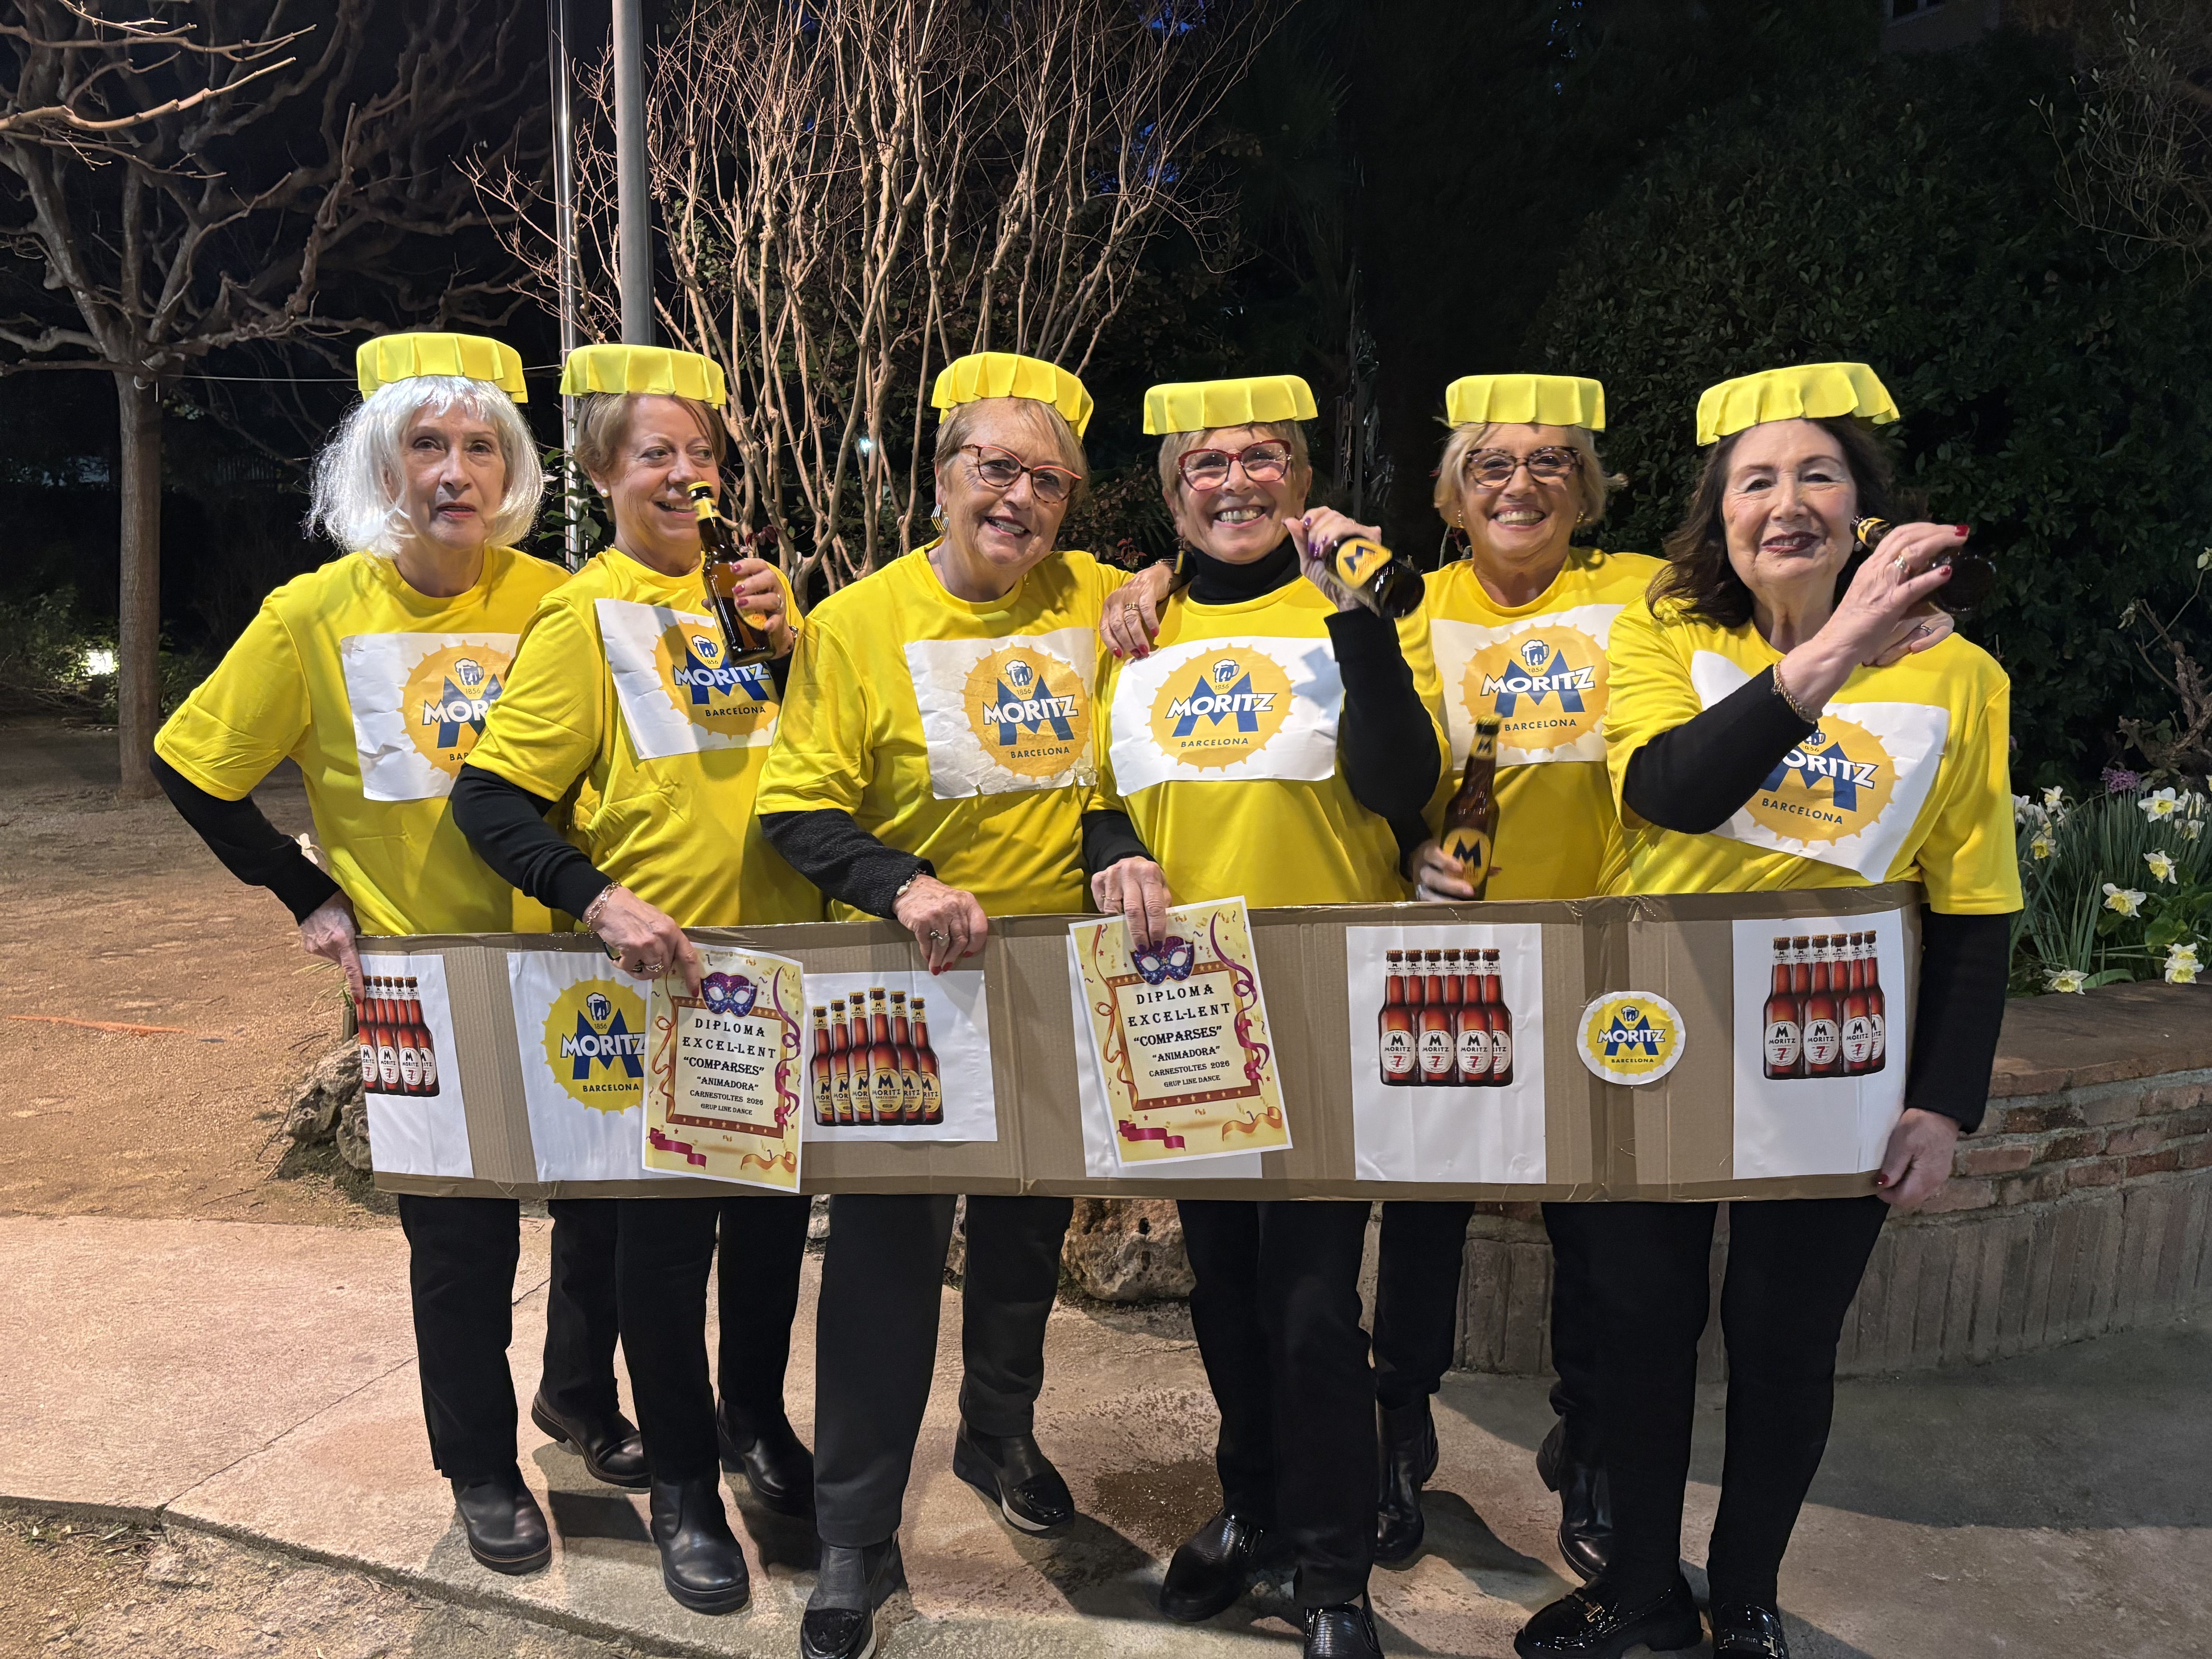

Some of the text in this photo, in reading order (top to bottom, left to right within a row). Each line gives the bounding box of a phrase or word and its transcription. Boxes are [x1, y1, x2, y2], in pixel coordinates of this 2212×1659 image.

[673, 663, 771, 686] MORITZ
[1480, 666, 1595, 696] MORITZ
[705, 706, 766, 716] BARCELONA
[982, 694, 1079, 725] MORITZ
[1165, 693, 1278, 719] MORITZ
[1505, 719, 1577, 731] BARCELONA
[1181, 738, 1249, 747] BARCELONA
[1011, 747, 1070, 759] BARCELONA
[1762, 798, 1843, 824] BARCELONA
[1453, 835, 1481, 868] M
[1136, 984, 1214, 1005] DIPLOMA
[1128, 1003, 1230, 1027] EXCEL-LENT
[695, 1018, 765, 1037] DIPLOMA
[1776, 1026, 1788, 1038] M
[1814, 1024, 1827, 1036] M
[1853, 1022, 1863, 1034] M
[1134, 1025, 1222, 1046] “COMPARSES”
[1391, 1035, 1404, 1046] M
[1429, 1035, 1442, 1046] M
[1467, 1034, 1480, 1046] M
[1597, 1029, 1666, 1043] MORITZ
[560, 1032, 646, 1058] MORITZ
[682, 1037, 776, 1058] EXCEL-LENT
[1855, 1043, 1862, 1056] 7
[363, 1049, 370, 1058] M
[384, 1050, 391, 1060] M
[406, 1052, 413, 1061] M
[1152, 1046, 1220, 1061] “ANIMADORA”
[1778, 1048, 1787, 1060] 7
[1816, 1046, 1826, 1058] 7
[684, 1056, 764, 1075] “COMPARSES”
[1393, 1056, 1402, 1067] 7
[1431, 1056, 1441, 1067] 7
[1470, 1056, 1479, 1068] 7
[366, 1067, 371, 1077] 7
[386, 1068, 392, 1079] 7
[1149, 1060, 1230, 1077] CARNESTOLTES 2026
[408, 1070, 414, 1080] 7
[583, 1084, 639, 1092] BARCELONA
[697, 1076, 759, 1091] “ANIMADORA”
[878, 1075, 894, 1089] M
[690, 1090, 743, 1102] CARNESTOLTES
[733, 1107, 752, 1115] DANCE
